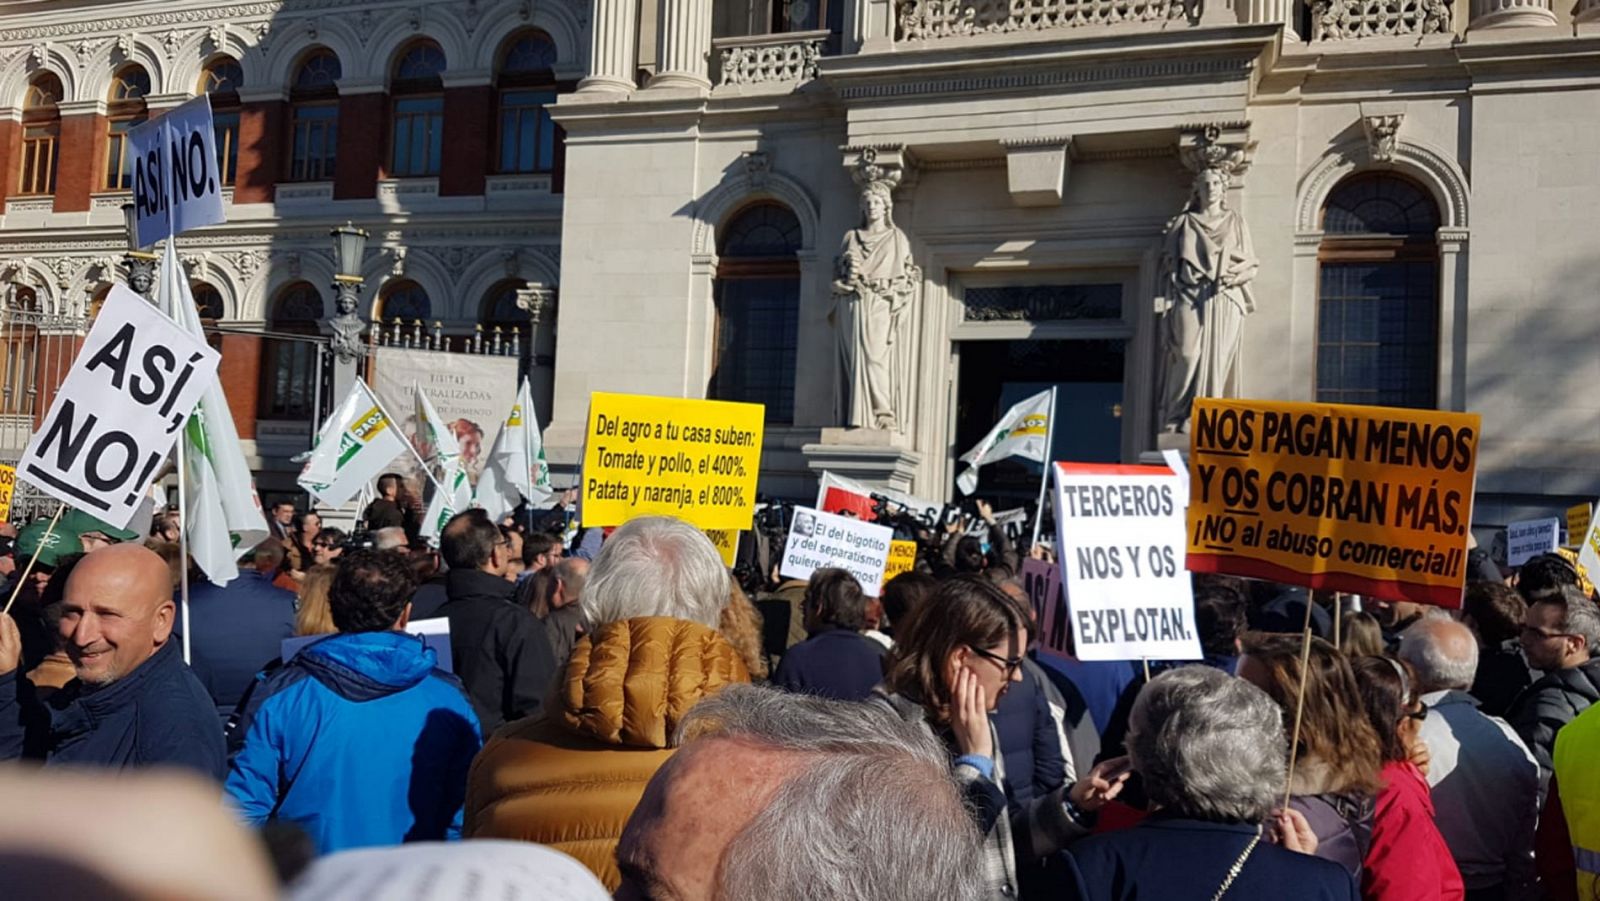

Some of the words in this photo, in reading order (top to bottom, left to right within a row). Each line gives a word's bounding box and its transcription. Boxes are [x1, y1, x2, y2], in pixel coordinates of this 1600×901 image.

[136, 131, 169, 223] ASÍ,
[171, 131, 214, 205] NO.
[85, 322, 203, 434] ASÍ,
[430, 374, 465, 385] VISITAS
[596, 414, 619, 436] Del
[622, 421, 650, 443] agro
[654, 423, 662, 439] a
[666, 421, 679, 441] tu
[682, 425, 711, 443] casa
[714, 425, 755, 447] suben:
[1197, 408, 1255, 451] NOS
[1261, 411, 1359, 461] PAGAN
[1365, 419, 1473, 472] MENOS
[35, 399, 161, 507] NO!
[598, 447, 644, 470] Tomate
[646, 455, 656, 476] y
[658, 452, 694, 477] pollo,
[698, 455, 710, 474] el
[712, 456, 747, 477] 400%.
[588, 478, 629, 500] Patata
[631, 485, 641, 505] y
[644, 483, 694, 509] naranja,
[699, 485, 710, 505] el
[712, 486, 747, 507] 800%.
[1064, 484, 1173, 517] TERCEROS
[1197, 464, 1216, 503] Y
[1222, 467, 1259, 509] OS
[1266, 471, 1389, 526] COBRAN
[1395, 479, 1465, 536] MÁS.
[790, 538, 800, 549] y
[801, 538, 818, 551] del
[820, 544, 882, 568] separatismo
[815, 523, 827, 536] El
[828, 527, 845, 541] del
[846, 531, 885, 551] bigotito
[1193, 514, 1237, 546] ¡NO
[1241, 520, 1264, 547] al
[1266, 524, 1333, 558] abuso
[1339, 539, 1462, 578] comercial!
[788, 554, 821, 570] quiere
[1077, 546, 1124, 580] NOS
[1125, 546, 1141, 578] Y
[1148, 545, 1176, 578] OS
[1077, 607, 1192, 644] EXPLOTAN.
